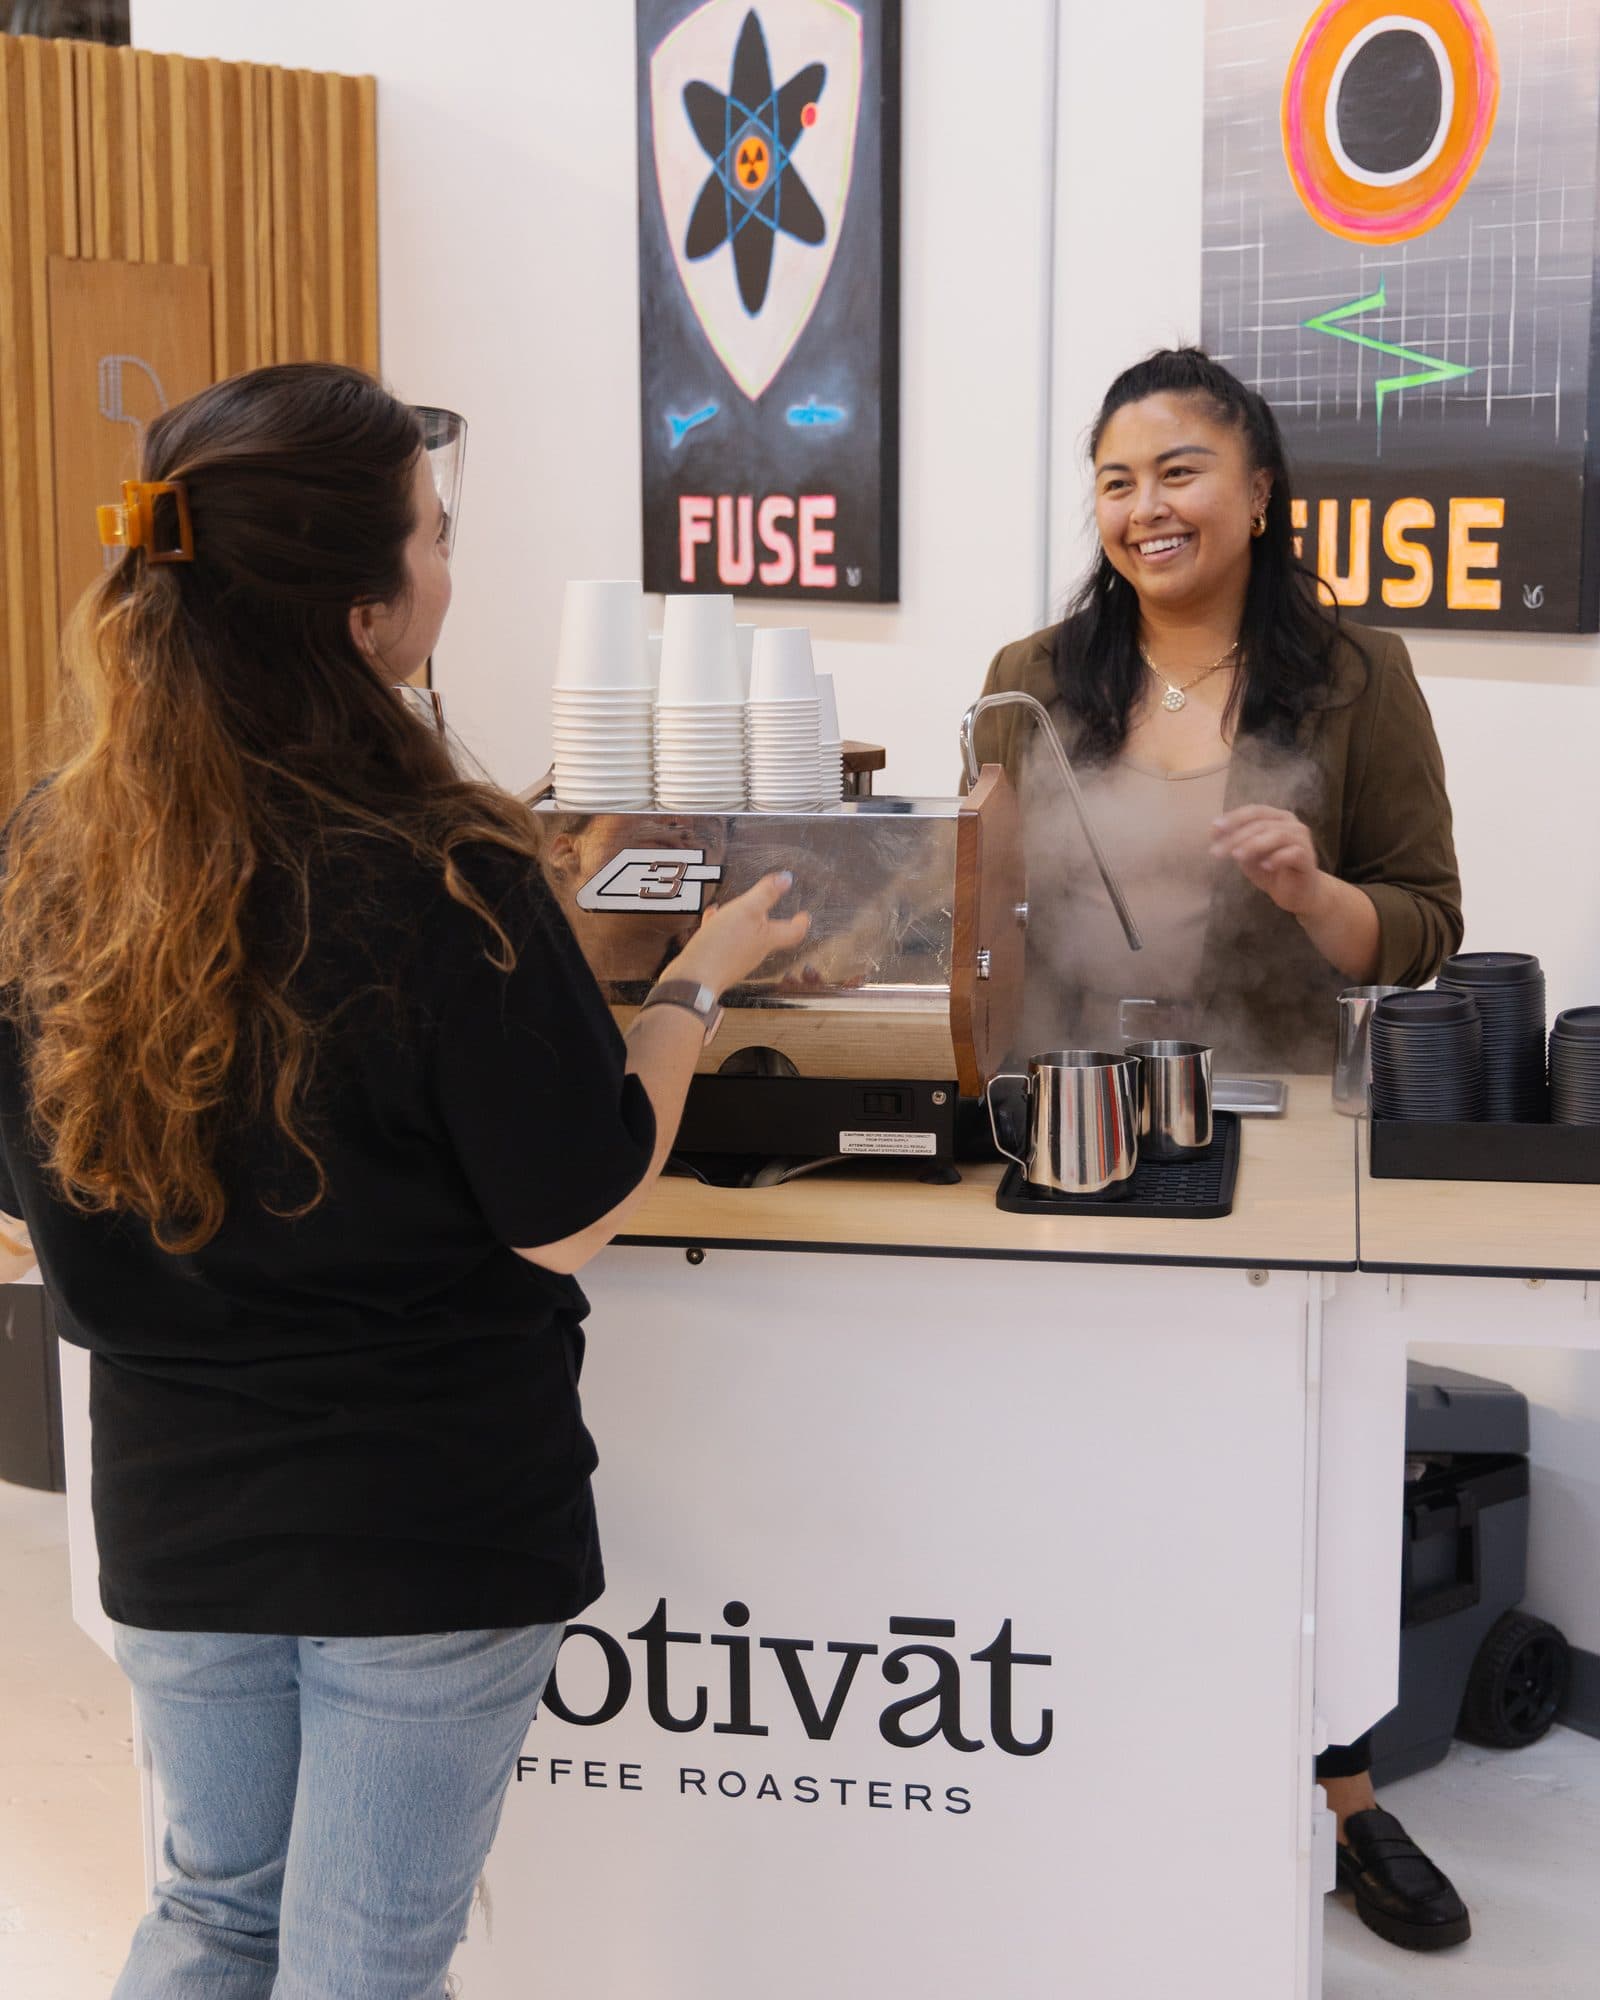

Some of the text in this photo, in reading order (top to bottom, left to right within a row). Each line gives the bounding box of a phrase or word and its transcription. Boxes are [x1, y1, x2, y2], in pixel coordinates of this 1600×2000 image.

[678, 495, 837, 588] FUSE
[531, 1597, 1053, 1756] otivāt
[517, 1757, 972, 1814] FFEE ROASTERS
